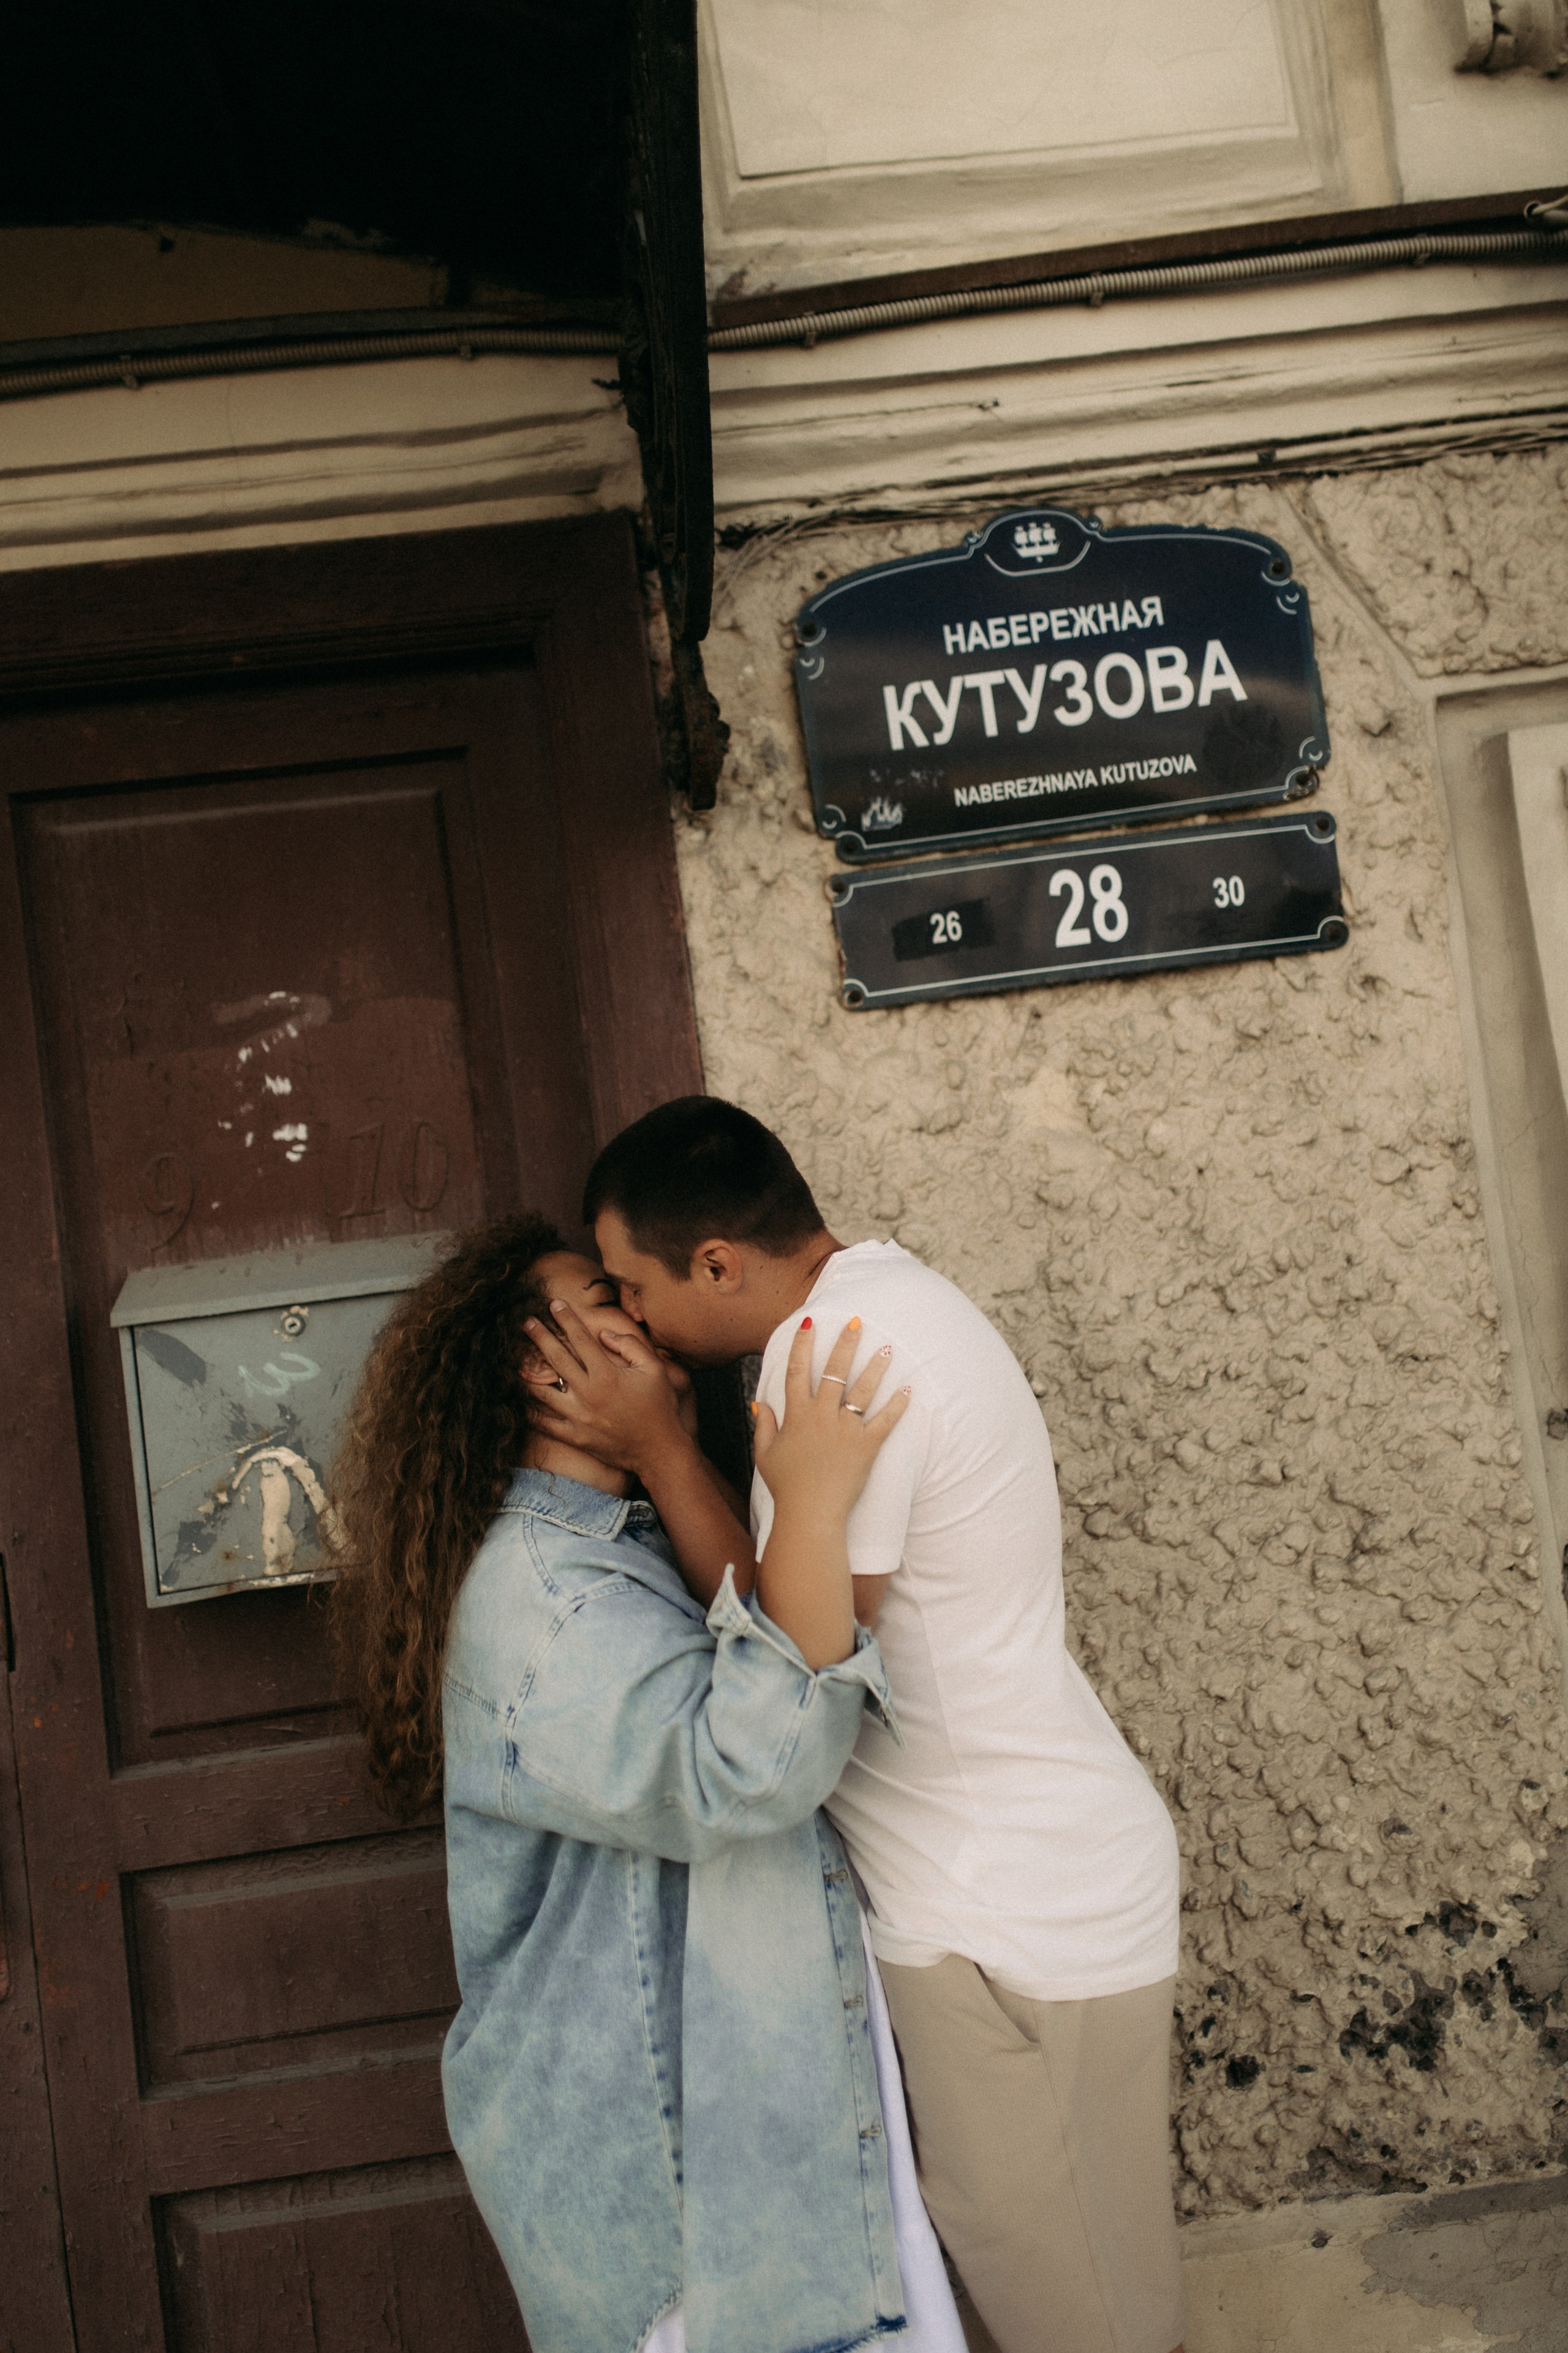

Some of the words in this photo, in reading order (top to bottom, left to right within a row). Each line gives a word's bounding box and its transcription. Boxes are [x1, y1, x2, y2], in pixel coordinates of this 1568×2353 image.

[943, 595, 1164, 655] НАБЕРЕЖНАЯ
[883, 639, 1248, 751] КУТУЗОВА
[954, 768, 1098, 807] NABEREZHNAYA
[1100, 754, 1197, 785] KUTUZOVA
[1049, 864, 1129, 949] 28
[1212, 875, 1245, 908] 30
[930, 911, 962, 944] 26
